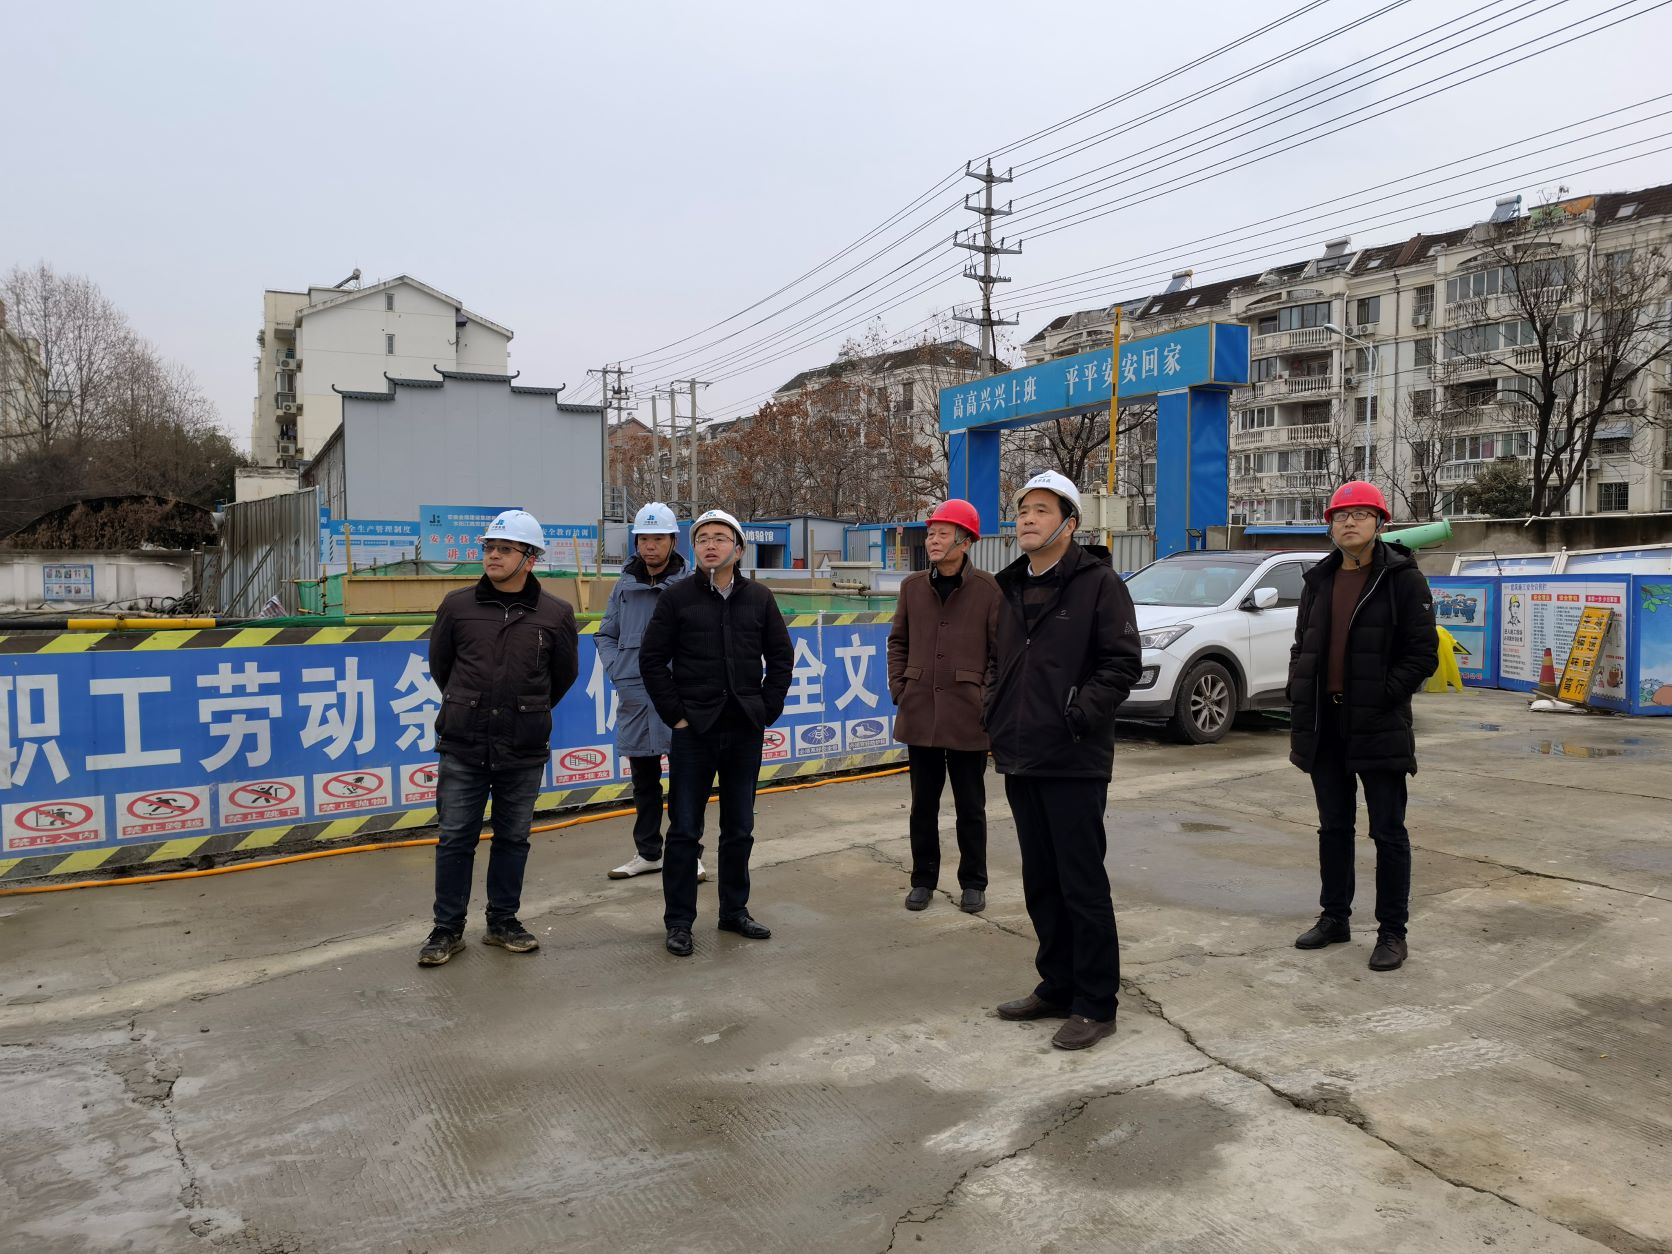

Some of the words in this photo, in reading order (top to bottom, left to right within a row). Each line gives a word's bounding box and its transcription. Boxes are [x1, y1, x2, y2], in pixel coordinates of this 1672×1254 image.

[952, 376, 1038, 420] 高高兴兴上班
[1064, 343, 1183, 396] 平平安安回家
[557, 770, 609, 783] 禁止堆放
[320, 797, 386, 812] 禁止抛物
[227, 808, 299, 823] 禁止跳下
[124, 819, 203, 835] 禁止跨越
[11, 831, 96, 848] 禁止入内
